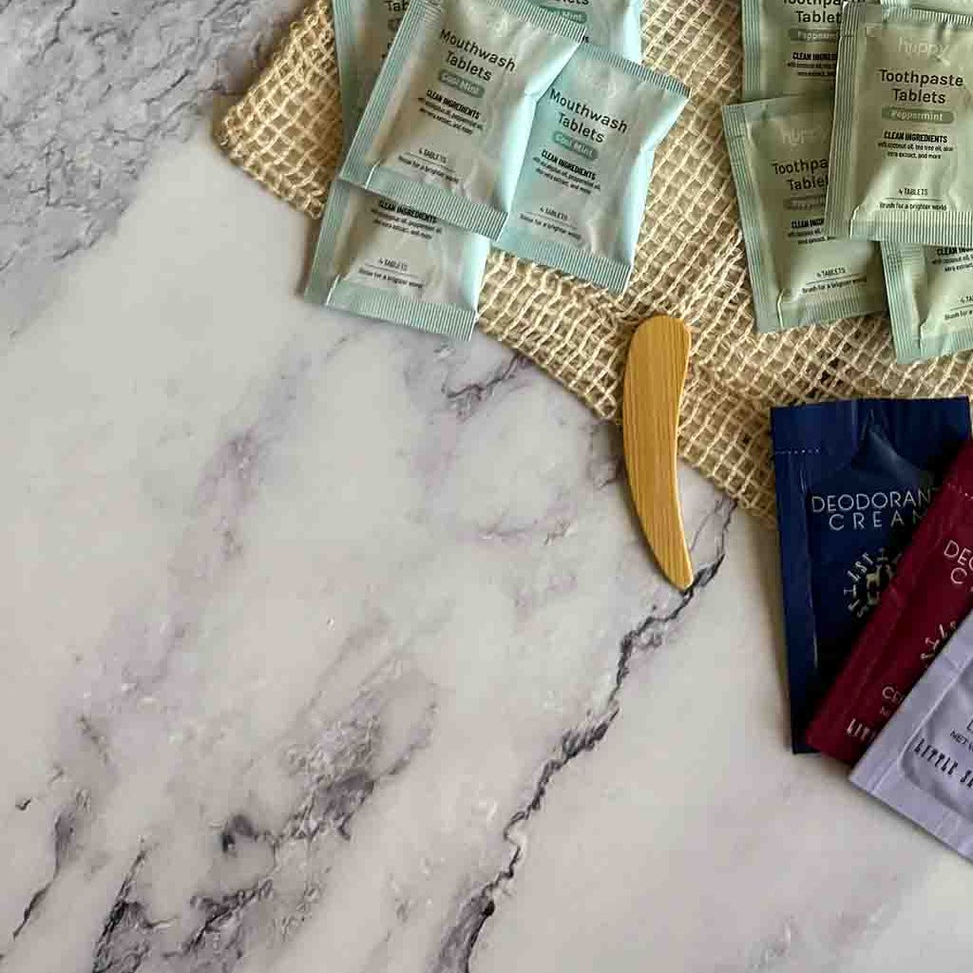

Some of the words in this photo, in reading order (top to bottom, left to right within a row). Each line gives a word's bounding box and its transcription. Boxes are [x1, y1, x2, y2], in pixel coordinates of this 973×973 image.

[440, 28, 516, 72] Mouthwash
[445, 49, 493, 82] Tablets
[878, 68, 964, 87] Toothpaste
[550, 88, 628, 134] Mouthwash
[892, 87, 947, 105] Tablets
[558, 111, 605, 144] Tablets
[884, 130, 905, 141] CLEAN
[904, 131, 949, 144] INGREDIENTS
[811, 486, 936, 513] DEODORAN
[949, 730, 968, 745] NET
[914, 737, 959, 776] LITTLE
